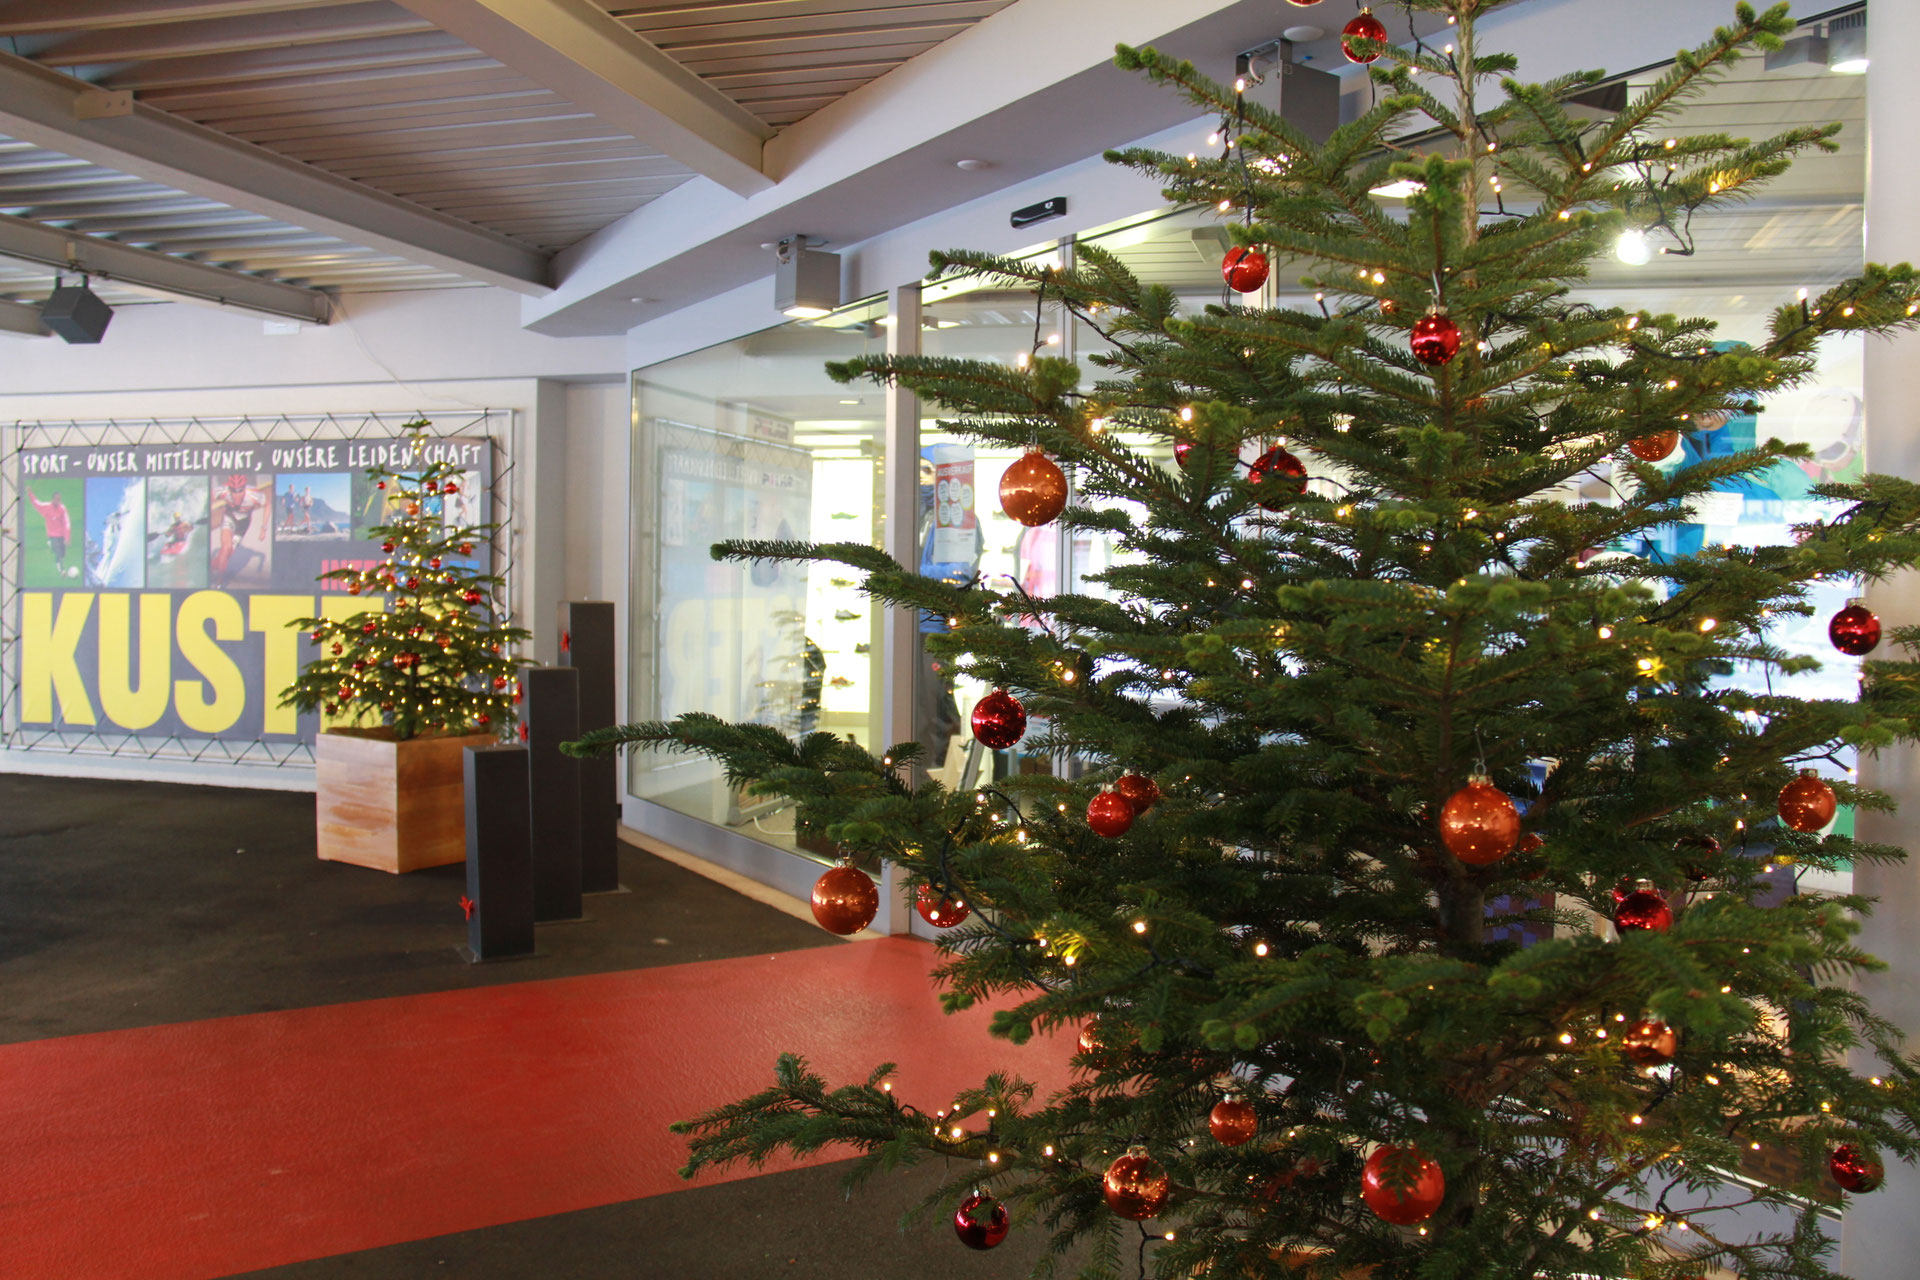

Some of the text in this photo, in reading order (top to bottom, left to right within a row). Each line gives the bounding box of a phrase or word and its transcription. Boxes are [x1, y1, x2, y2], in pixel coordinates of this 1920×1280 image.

[23, 453, 69, 474] SPORT
[87, 450, 138, 472] UNSER
[146, 448, 262, 472] MITTELPUNKT,
[272, 446, 340, 469] UNSERE
[348, 443, 482, 468] LEIDENCHAFT
